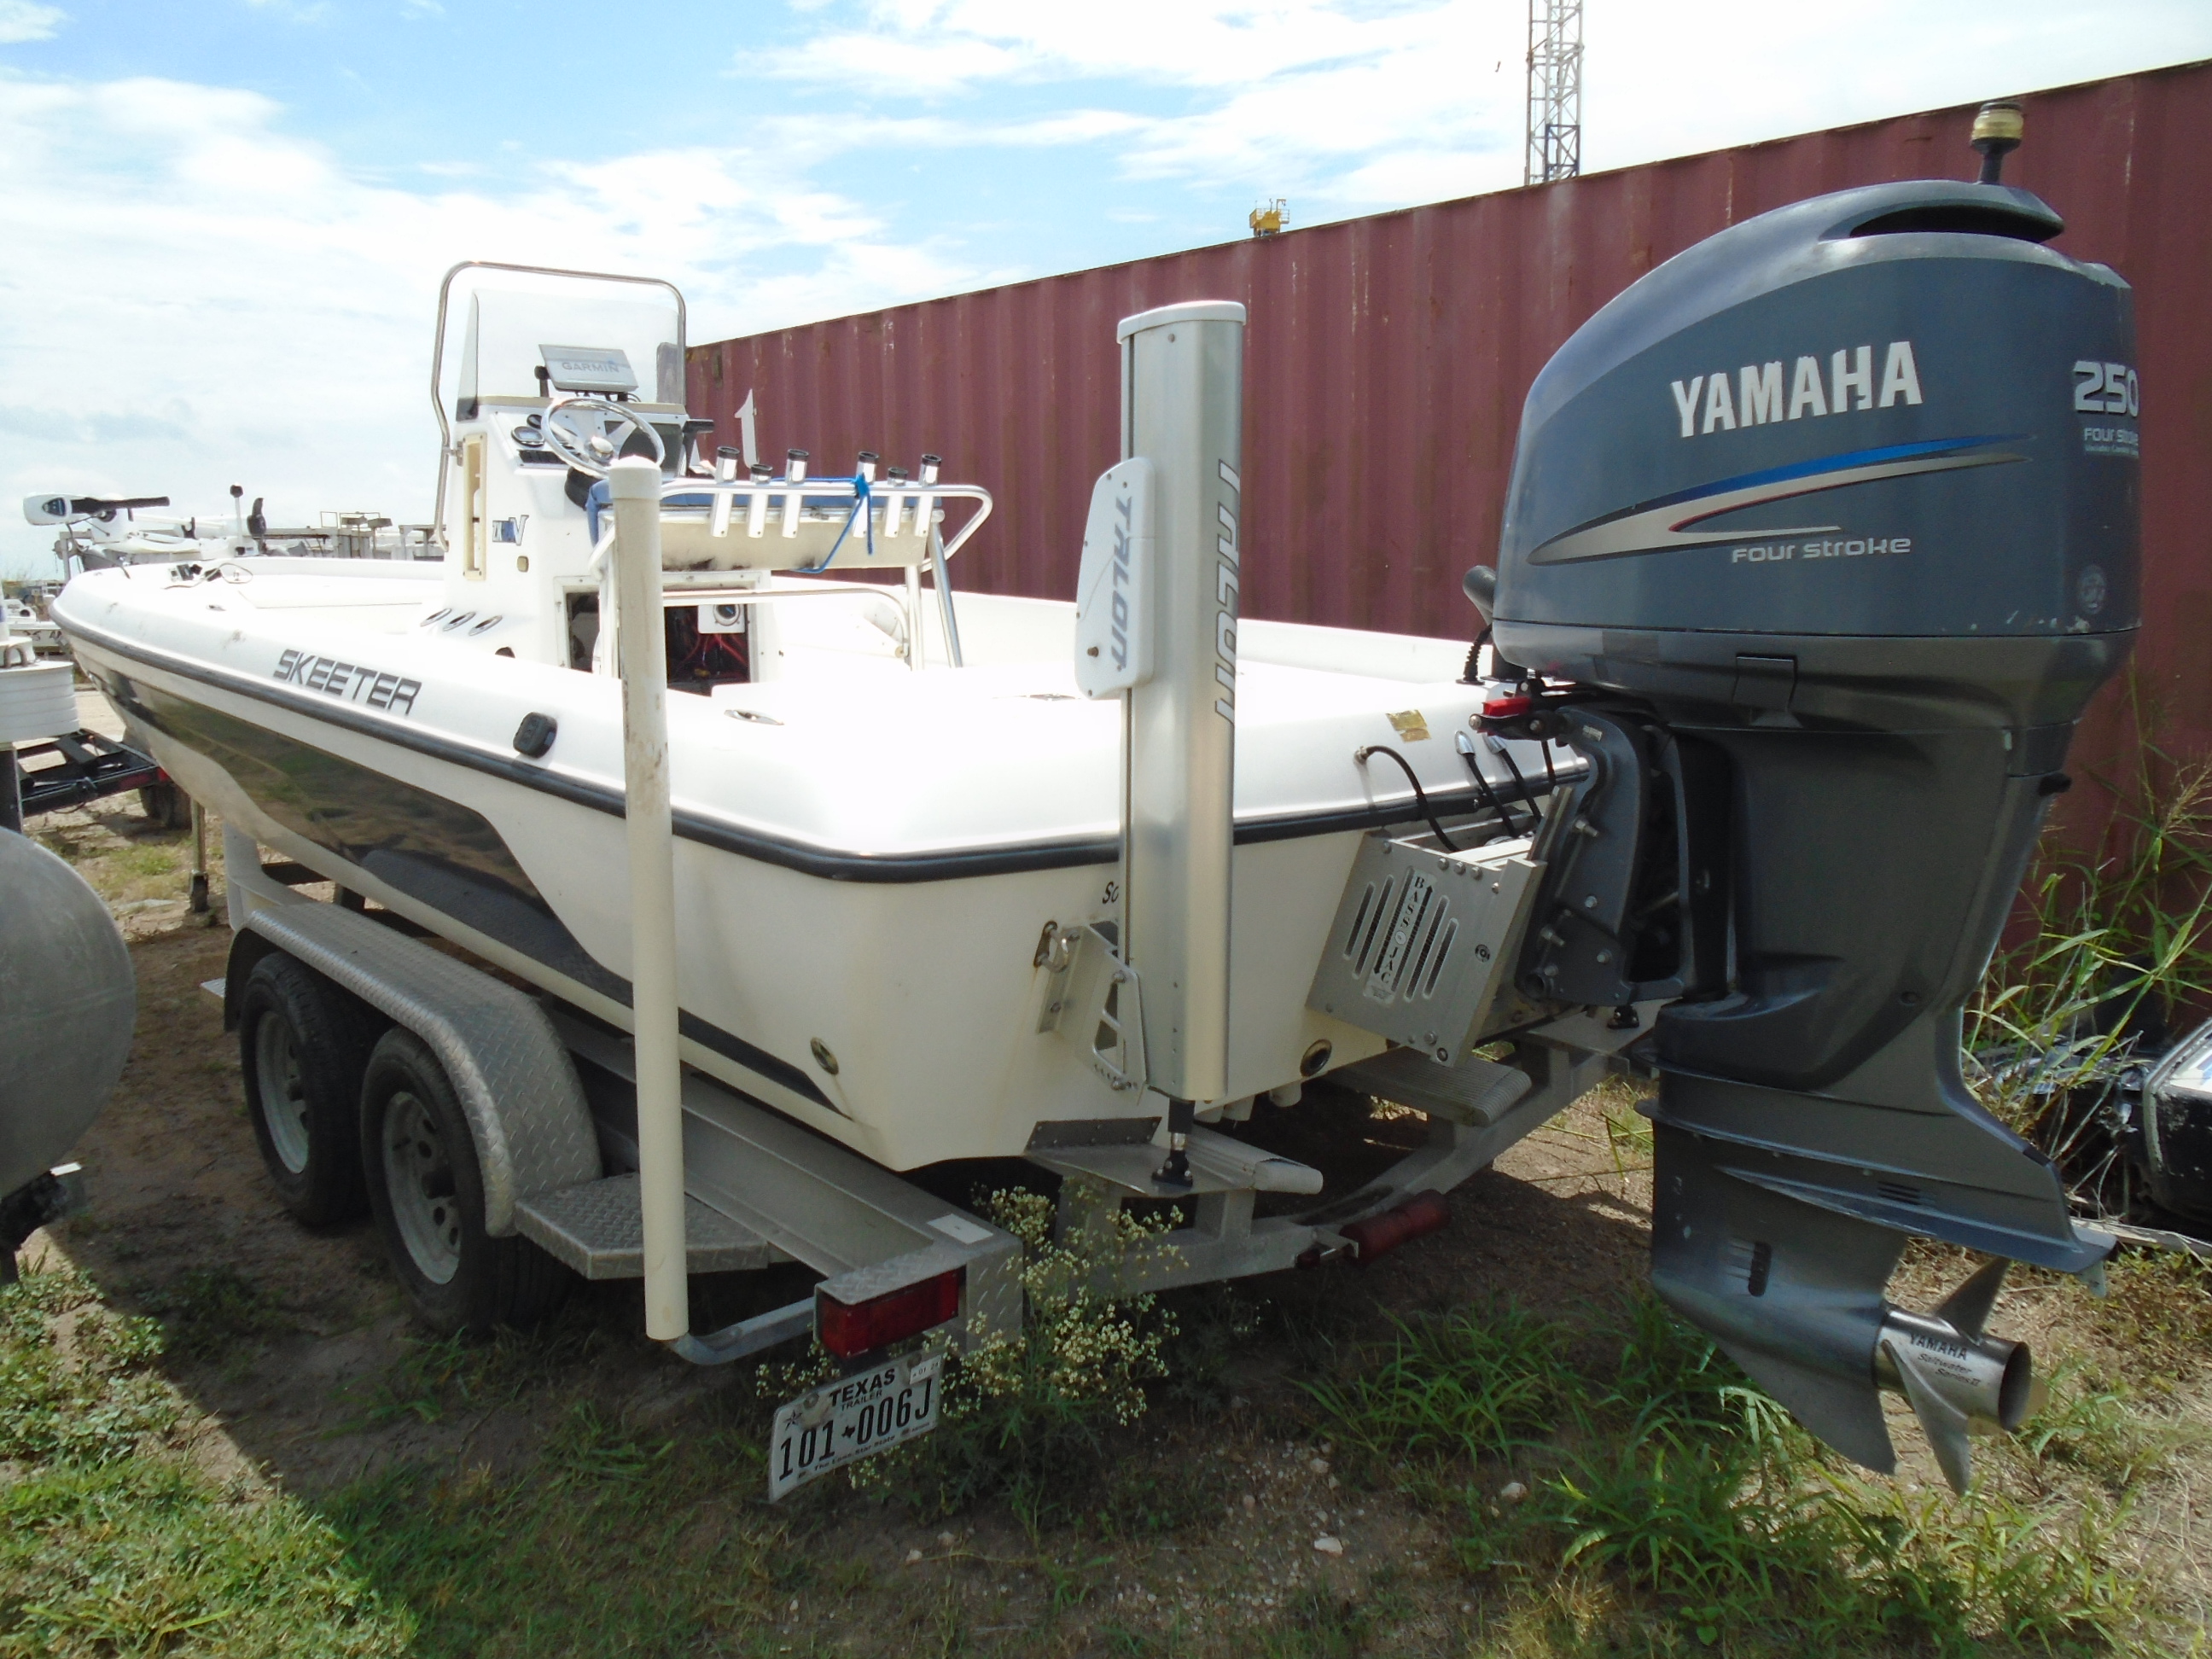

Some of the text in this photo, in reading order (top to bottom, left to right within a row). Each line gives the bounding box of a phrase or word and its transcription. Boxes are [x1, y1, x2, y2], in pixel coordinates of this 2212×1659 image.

[562, 362, 620, 373] GARMIN
[1670, 341, 1924, 439] YAMAHA
[2073, 360, 2139, 417] 250
[1110, 496, 1132, 670] TALON
[272, 649, 422, 717] SKEETER
[1400, 876, 1426, 928] BASS
[1910, 1334, 1967, 1361] YAMAHA
[1917, 1353, 1973, 1374] Saltwater
[829, 1368, 896, 1407] TEXAS
[841, 1389, 883, 1412] TRAILER
[814, 1461, 830, 1472] The
[854, 1445, 872, 1456] Star
